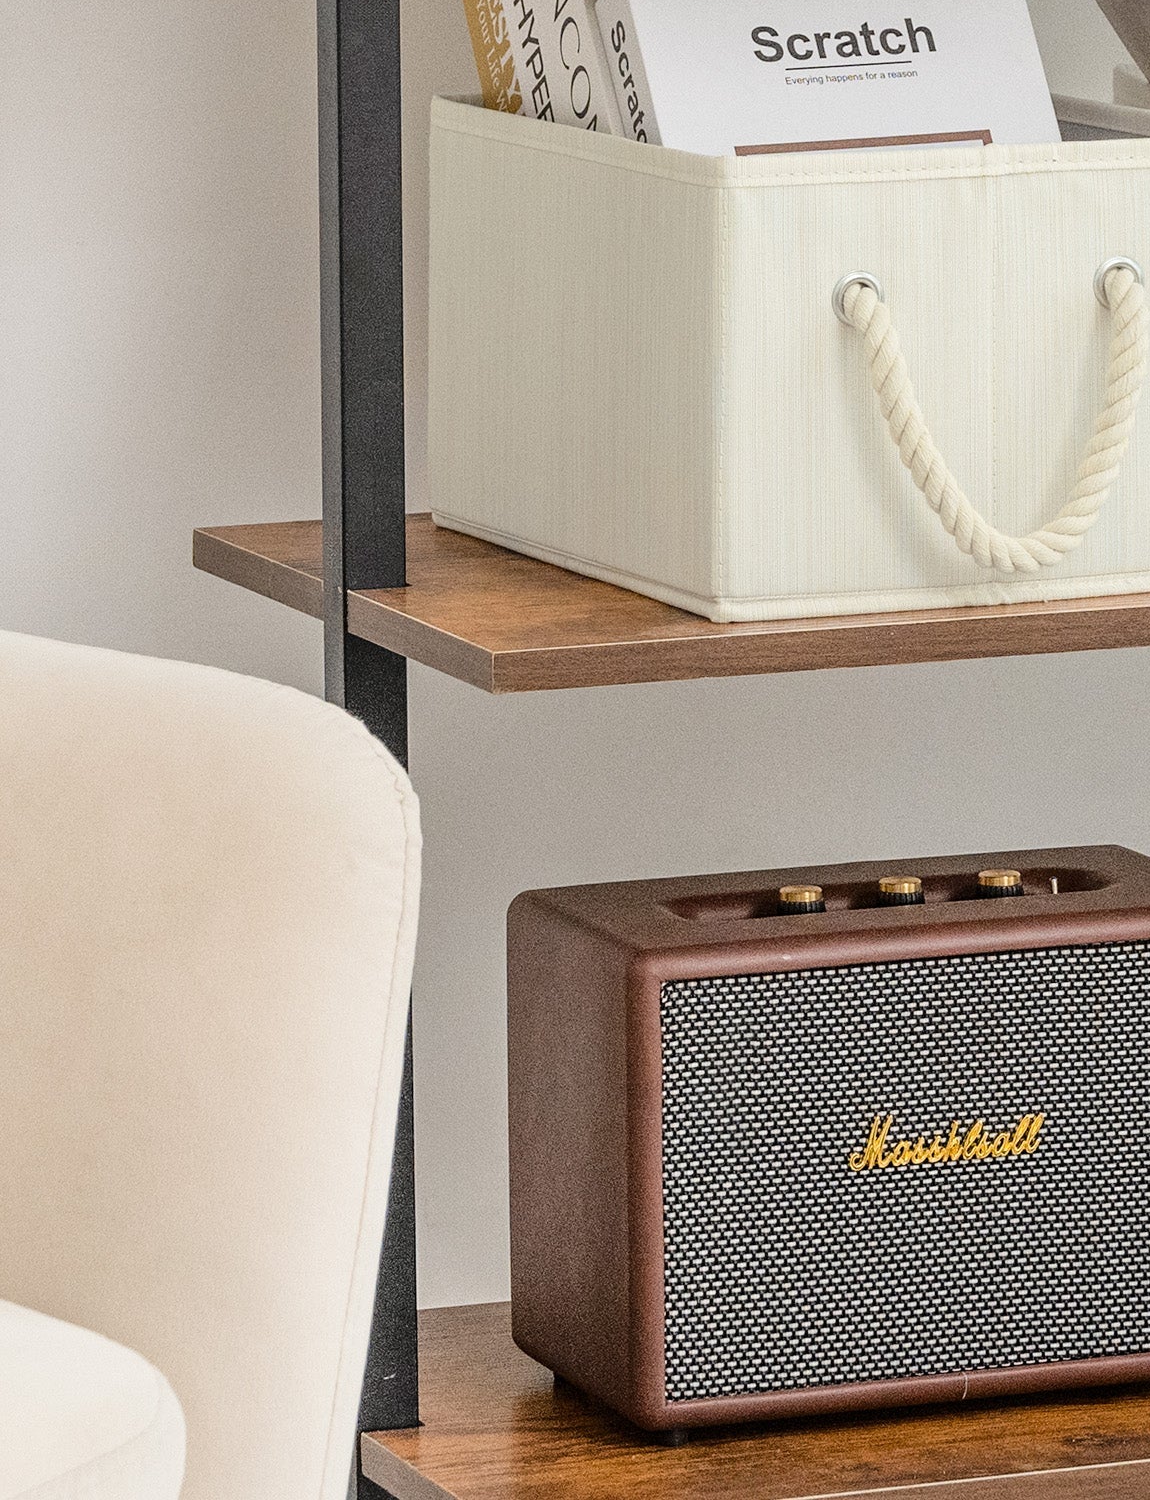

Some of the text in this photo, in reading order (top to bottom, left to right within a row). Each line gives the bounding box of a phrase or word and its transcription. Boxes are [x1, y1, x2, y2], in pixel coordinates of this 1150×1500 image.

[751, 18, 936, 62] Scratch
[485, 48, 501, 90] Life
[825, 70, 864, 84] happens
[865, 70, 879, 80] for
[879, 71, 886, 79] a
[887, 69, 918, 78] reason
